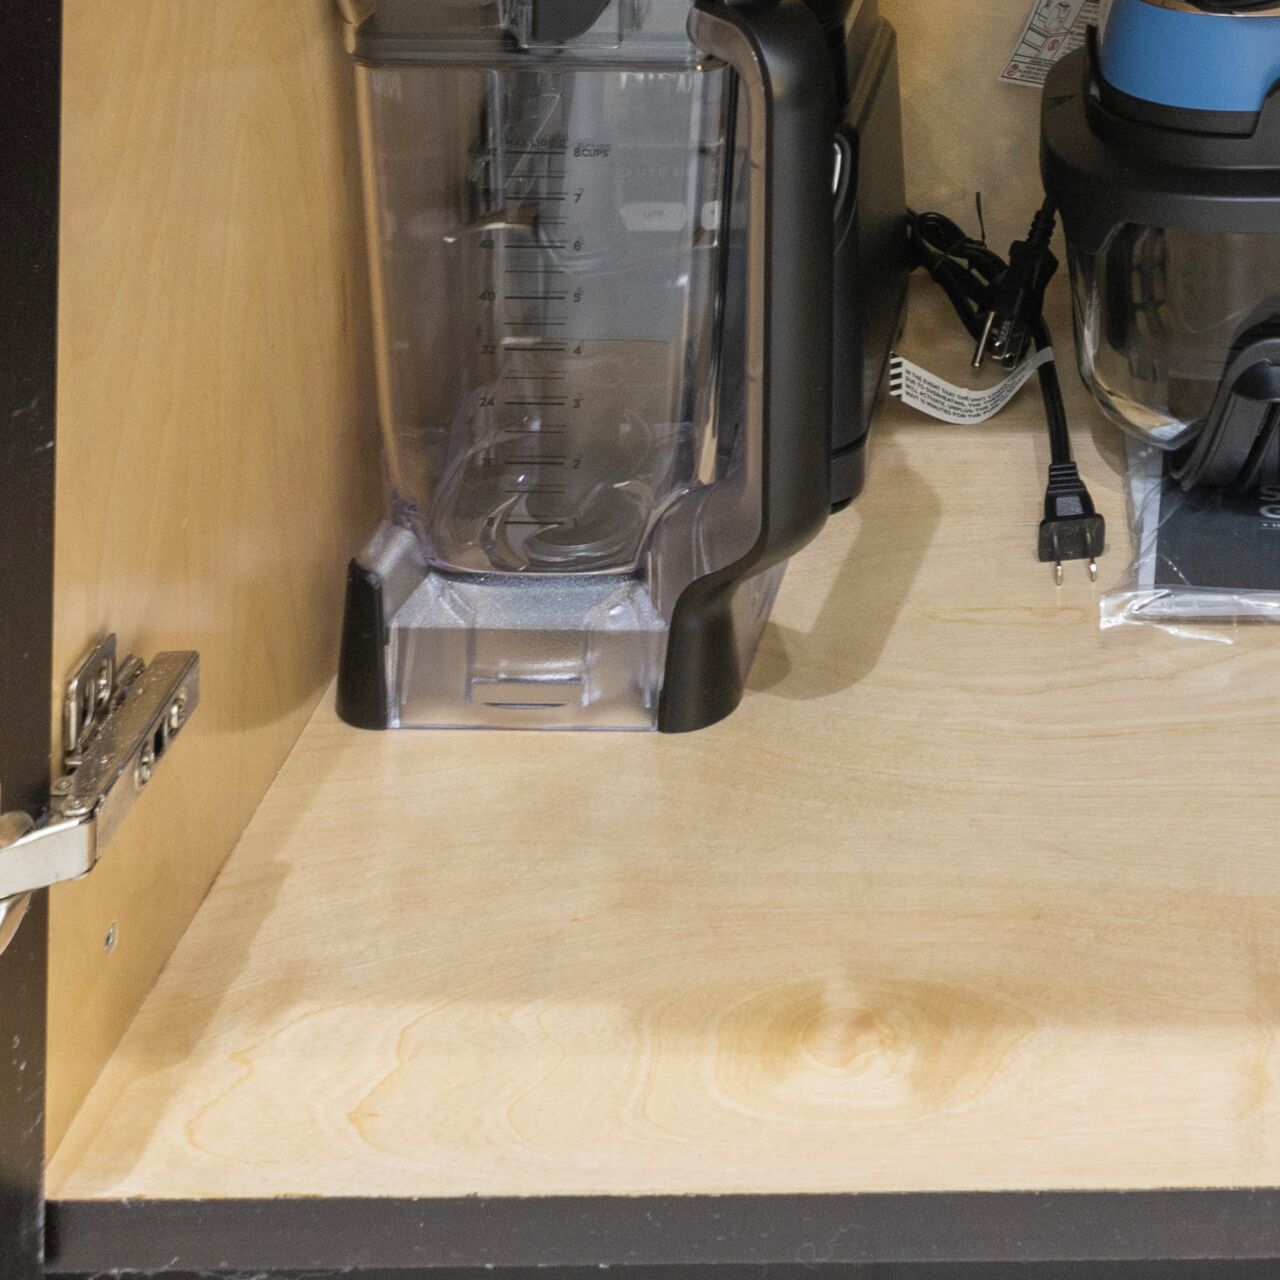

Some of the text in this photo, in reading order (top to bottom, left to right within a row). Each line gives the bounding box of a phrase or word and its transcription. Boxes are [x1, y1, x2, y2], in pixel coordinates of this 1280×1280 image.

[479, 292, 496, 302] 40
[480, 345, 497, 354] 32
[480, 397, 495, 407] 24
